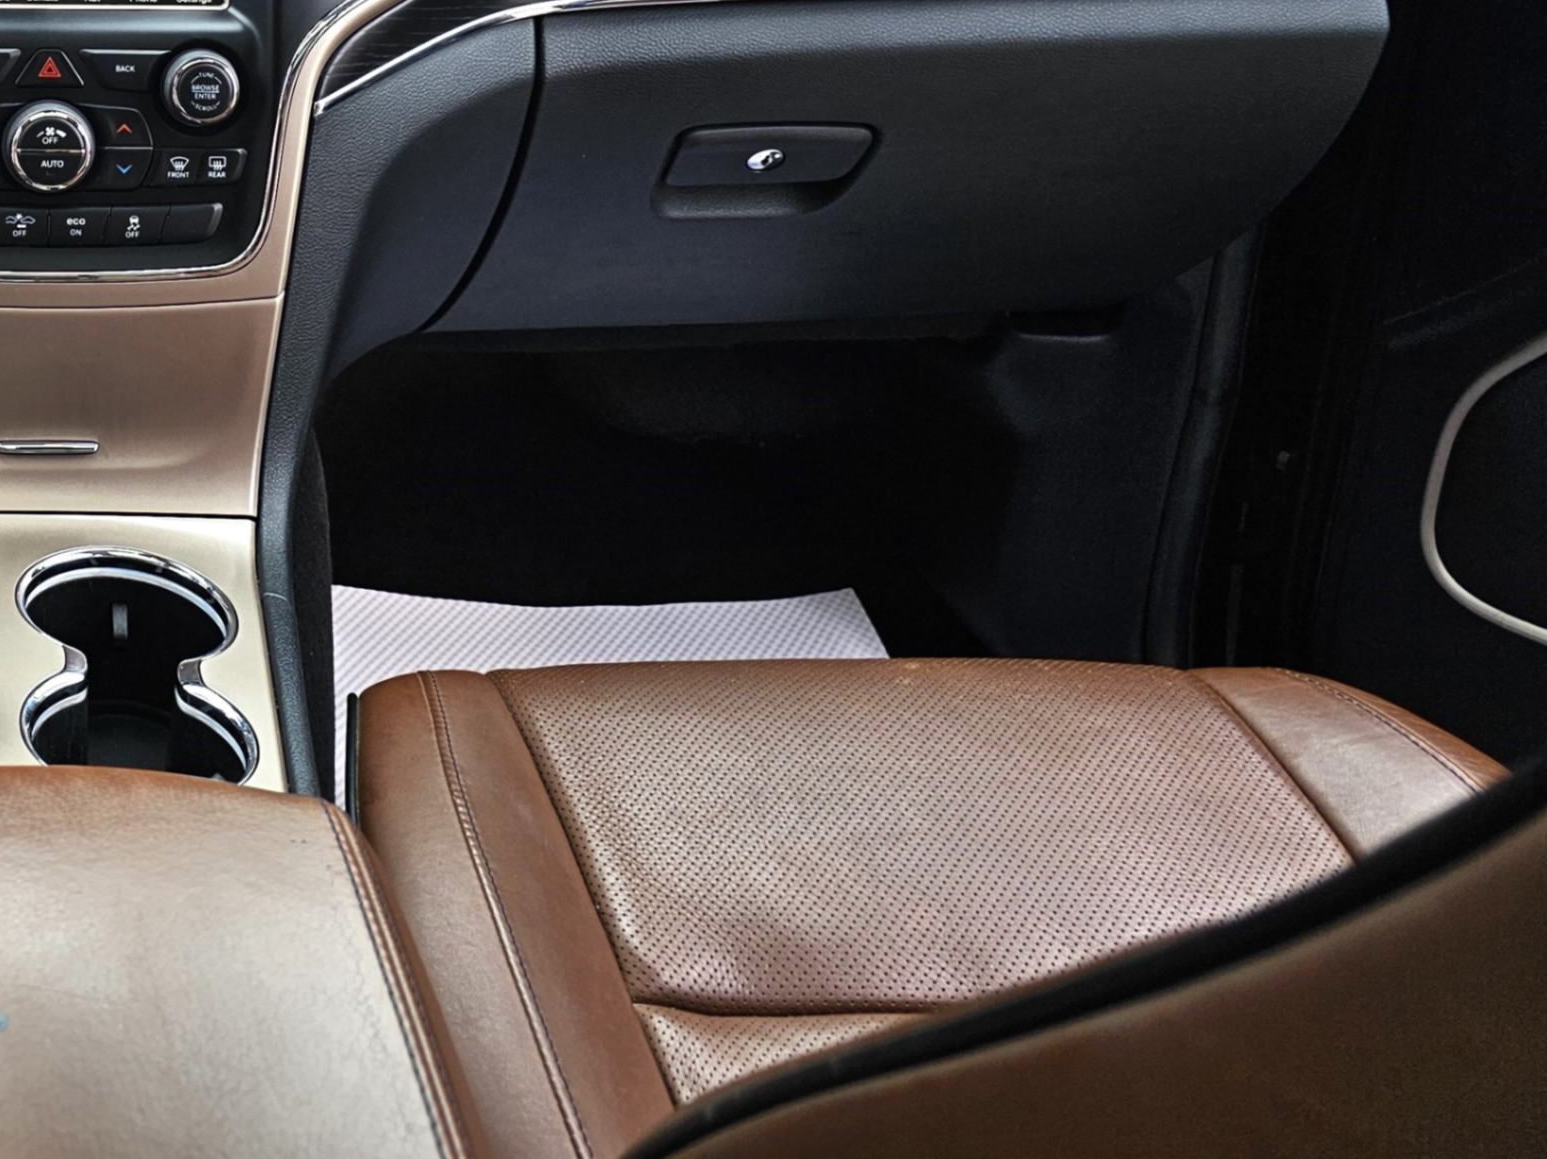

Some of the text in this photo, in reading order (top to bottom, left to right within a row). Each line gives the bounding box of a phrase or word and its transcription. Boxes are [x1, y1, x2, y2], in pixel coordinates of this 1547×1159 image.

[115, 65, 135, 73] BACK
[41, 137, 58, 145] OFF
[41, 160, 65, 168] AUTO
[66, 217, 86, 226] eco
